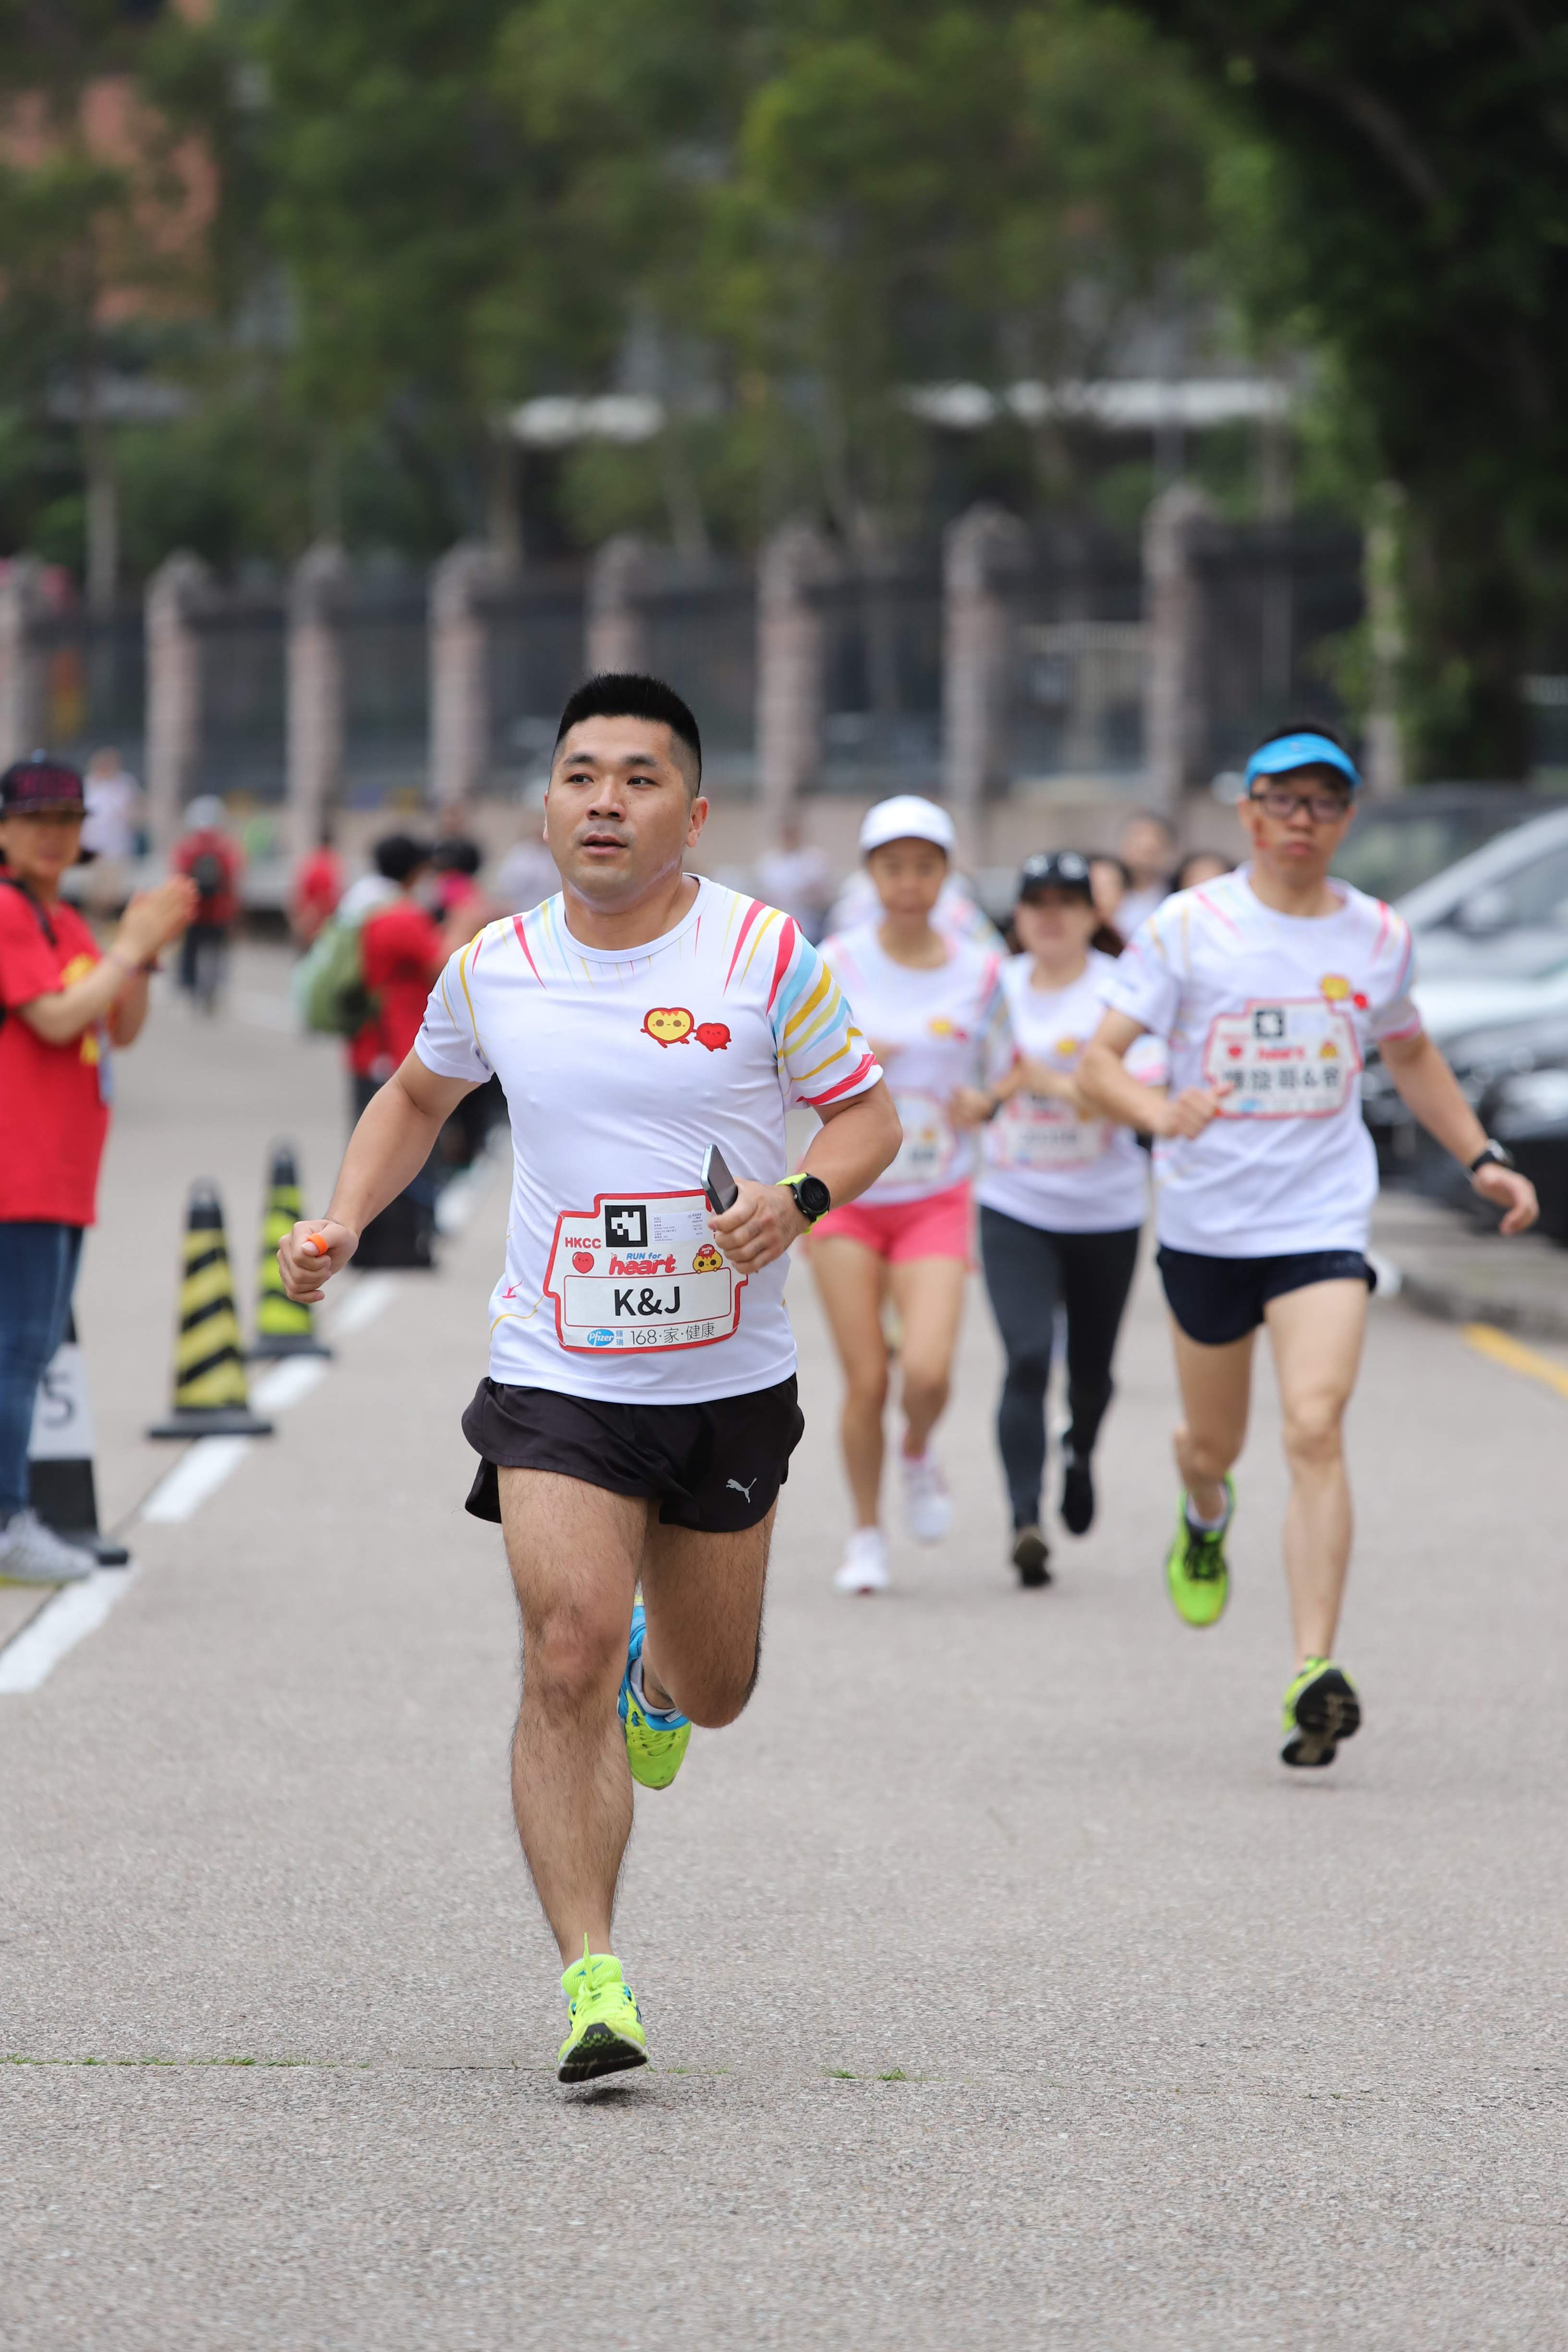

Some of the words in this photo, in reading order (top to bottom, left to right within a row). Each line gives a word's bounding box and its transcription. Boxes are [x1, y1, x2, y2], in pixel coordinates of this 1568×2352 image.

[565, 1237, 601, 1249] HKCC
[608, 1254, 676, 1275] heart
[614, 1286, 681, 1316] K&J
[589, 1331, 614, 1346] Pfizer
